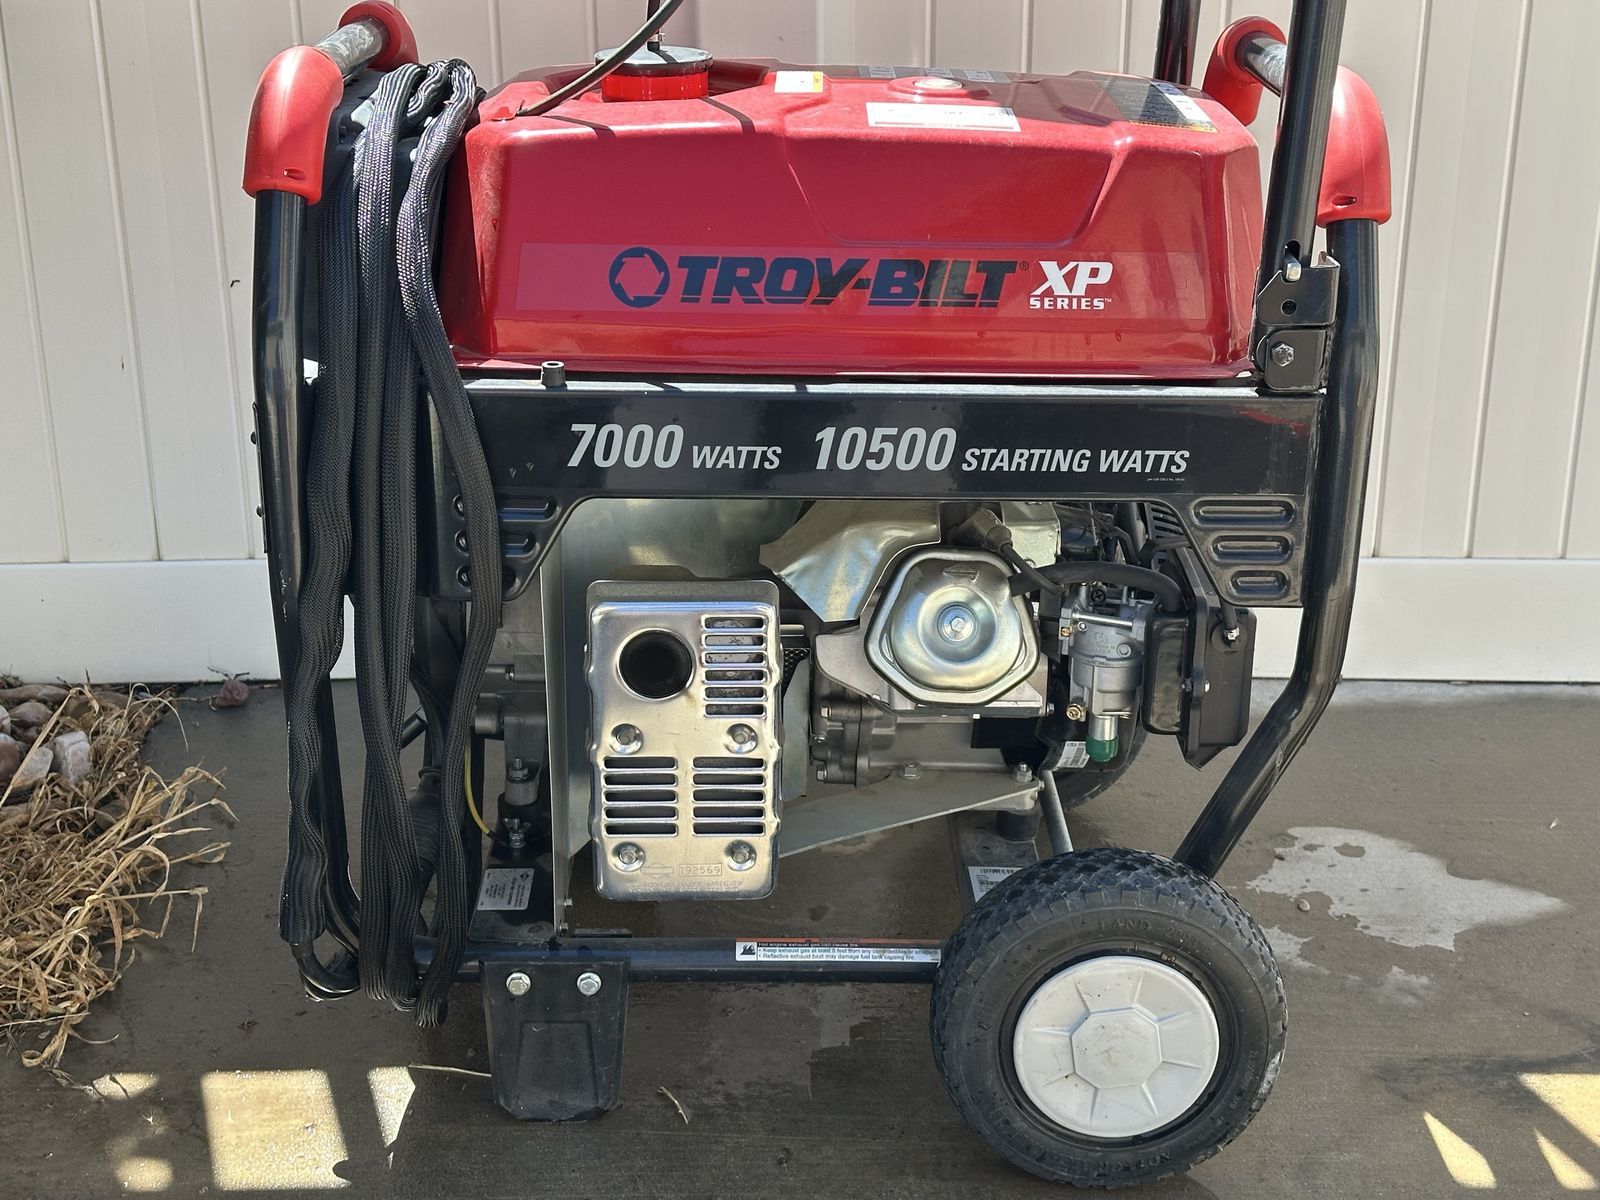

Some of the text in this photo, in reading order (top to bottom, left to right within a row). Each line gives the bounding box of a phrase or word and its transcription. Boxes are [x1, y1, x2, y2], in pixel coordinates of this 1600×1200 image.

[1030, 260, 1113, 296] XP
[567, 423, 1190, 473] 7000 WATTS 10500 STARTING WATTS
[681, 866, 720, 875] 192569
